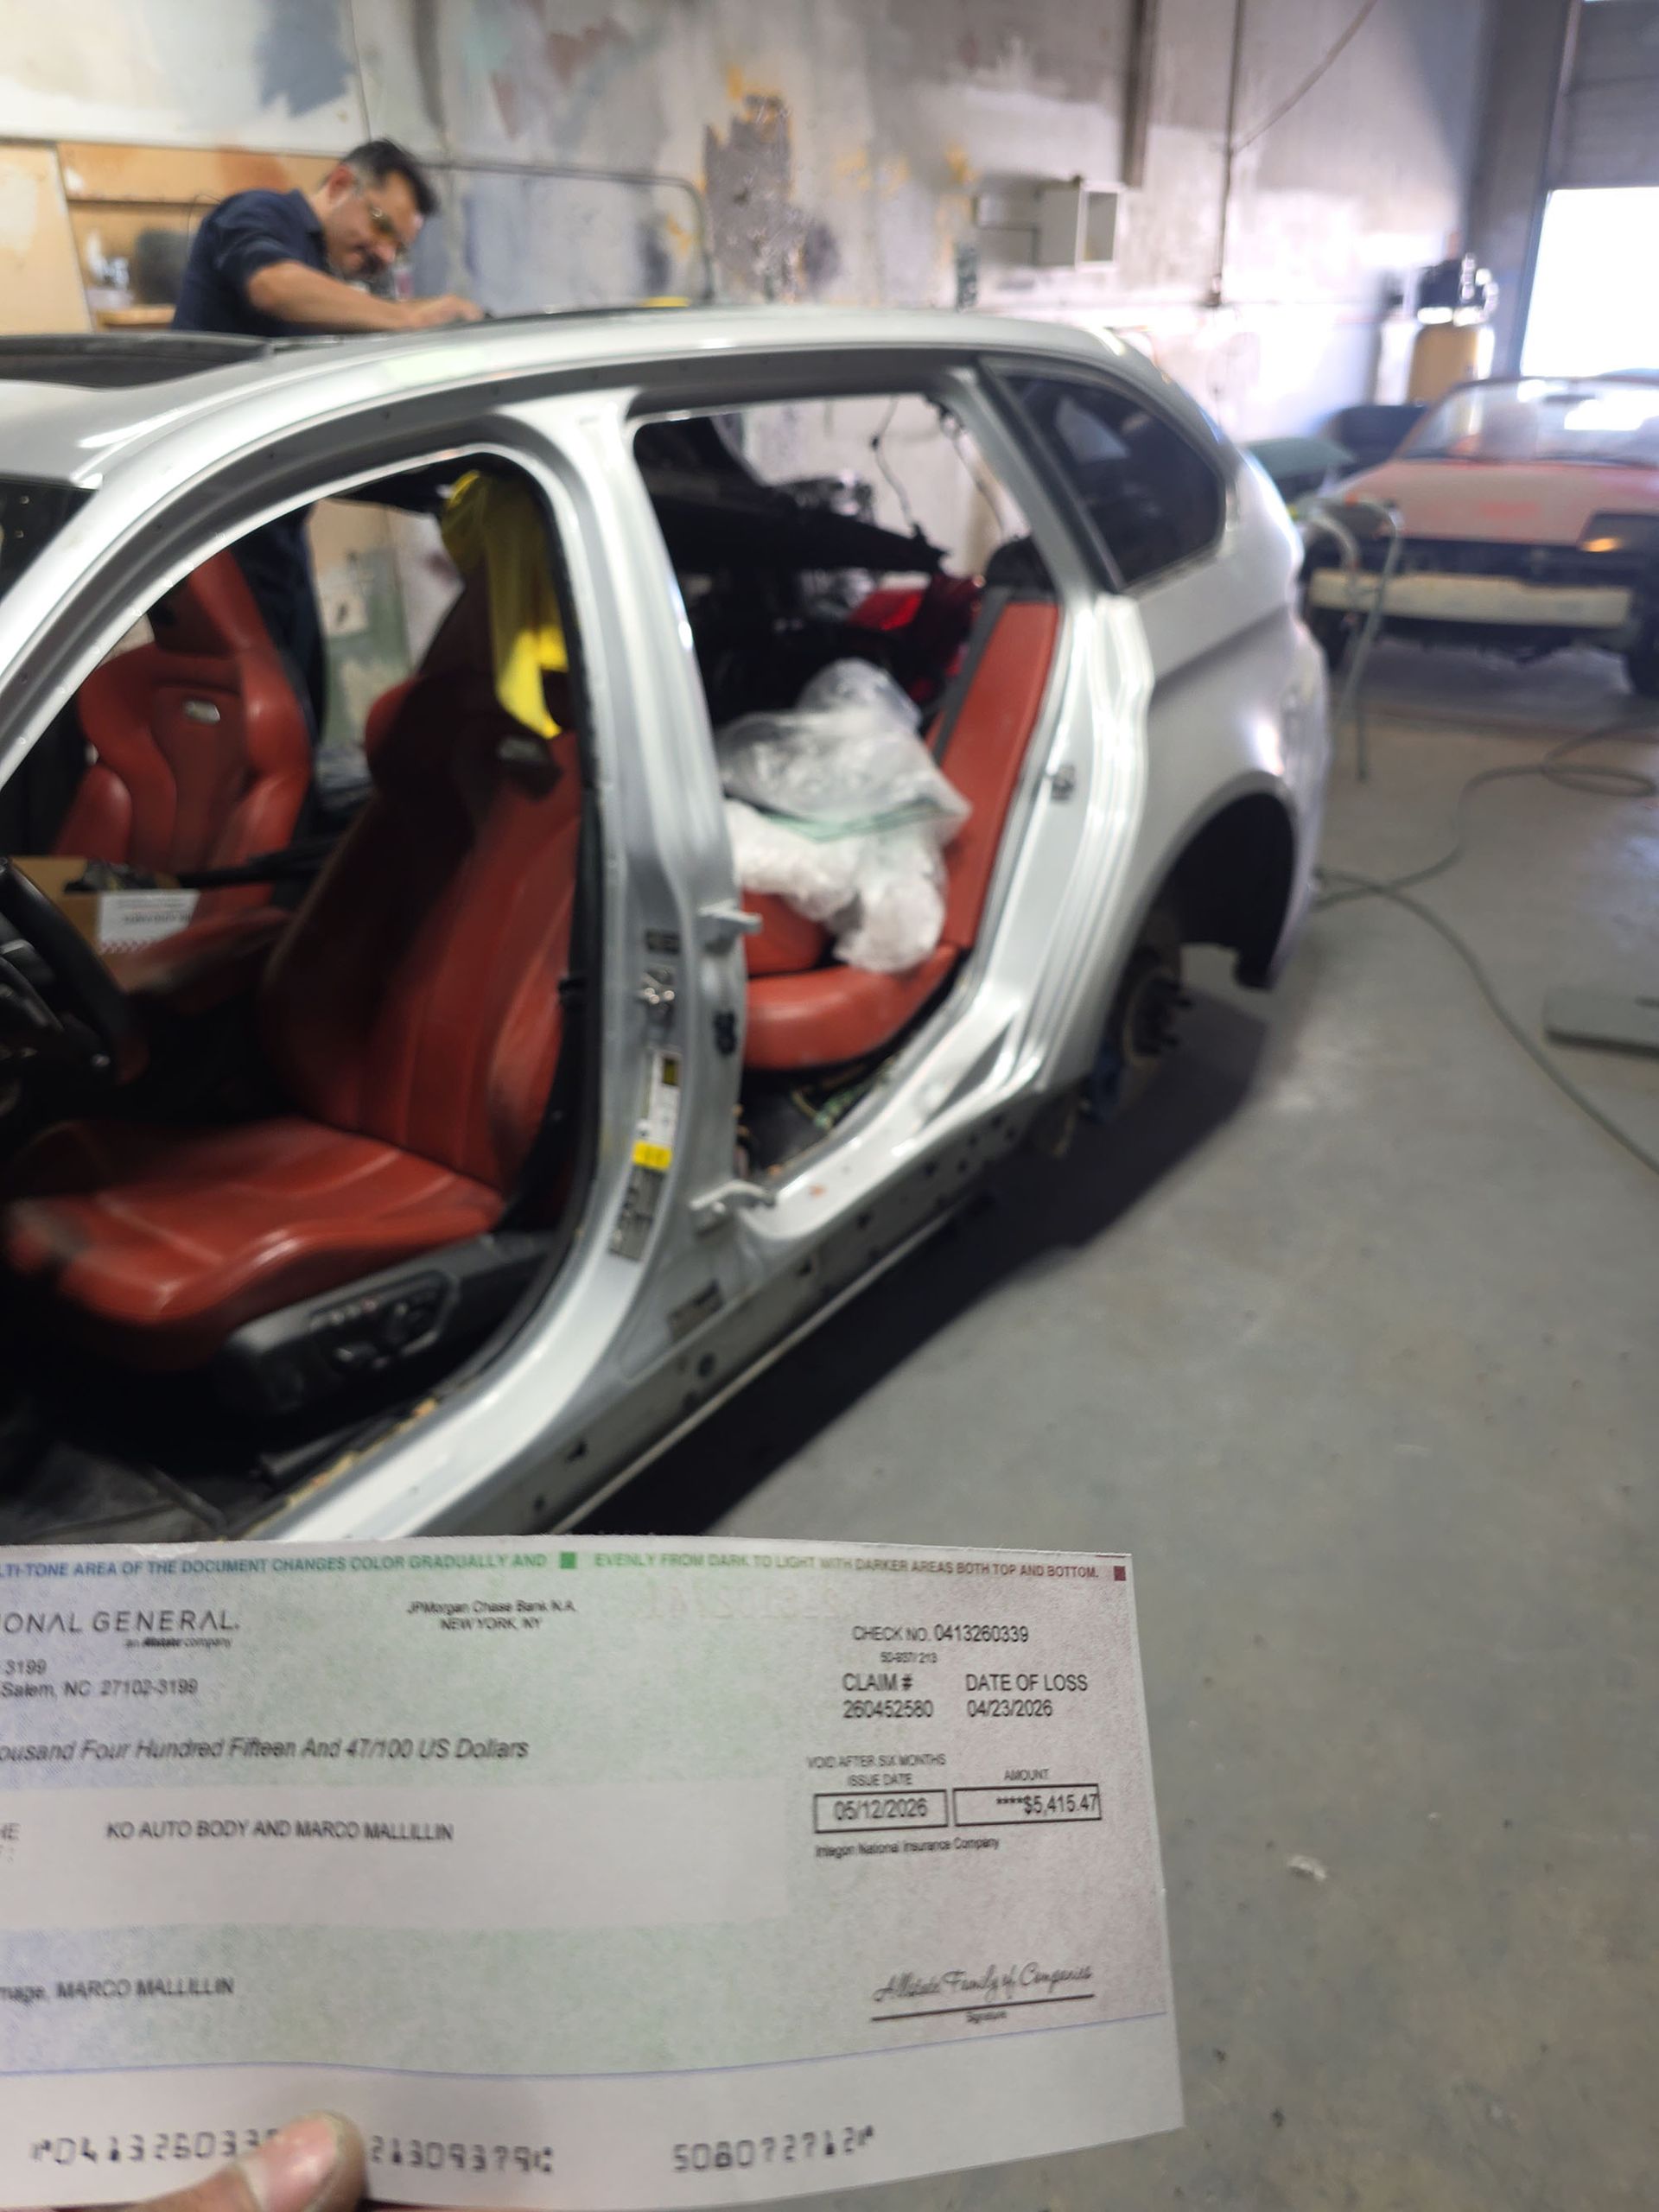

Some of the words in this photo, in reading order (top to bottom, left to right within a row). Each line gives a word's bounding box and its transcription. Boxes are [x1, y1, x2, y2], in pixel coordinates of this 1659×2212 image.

[73, 1561, 118, 1577] AREA
[122, 1560, 143, 1575] OF
[147, 1559, 175, 1574] THE
[181, 1558, 267, 1574] DOCUMENT
[273, 1556, 346, 1572] CHANGES
[351, 1556, 405, 1571] COLOR
[410, 1554, 507, 1569] GRADUALLY
[512, 1554, 548, 1568] AND
[594, 1553, 653, 1567] EVENLY
[660, 1554, 705, 1567] FROM
[709, 1554, 748, 1567] DARK
[753, 1555, 772, 1568] TO
[777, 1555, 816, 1569] LIGHT
[820, 1556, 852, 1570] WITH
[855, 1558, 909, 1573] DARKER
[911, 1560, 954, 1574] AREAS
[956, 1561, 990, 1575] BOTH
[992, 1562, 1016, 1576] TOP
[1020, 1563, 1044, 1578] AND
[1047, 1565, 1099, 1580] BOTTOM.
[407, 1600, 469, 1616] JPMorgan
[474, 1599, 512, 1613] Chase
[517, 1599, 548, 1613] Bank
[0, 1612, 83, 1634] ONAL
[440, 1617, 474, 1630] NEW
[522, 1616, 542, 1630] NY
[852, 1625, 903, 1642] CHECK
[906, 1627, 931, 1643] NO.
[933, 1624, 1028, 1643] 0413260339
[5, 1659, 47, 1676] 3199
[64, 1681, 92, 1697] NC
[100, 1678, 198, 1696] 27102-3199
[842, 1673, 898, 1691] CLAIM
[902, 1673, 913, 1691] #
[965, 1673, 1012, 1692] DATE
[1015, 1673, 1039, 1692] OF
[1043, 1673, 1089, 1692] LOSS
[966, 1699, 1053, 1718] 04/23/2026
[81, 1738, 130, 1759] Four
[136, 1738, 226, 1758] Hundred
[229, 1737, 296, 1758] Fifteen
[302, 1738, 342, 1758] And
[346, 1738, 414, 1758] 47/100
[418, 1738, 450, 1758] US
[454, 1738, 531, 1758] Dollars
[807, 1756, 836, 1768] VOID
[839, 1755, 877, 1768] AFTER
[879, 1755, 897, 1767] SIX
[899, 1753, 946, 1766] MONTHS
[847, 1774, 880, 1787] ISSUE
[882, 1773, 912, 1786] DATE
[1004, 1769, 1049, 1782] AMOUNT
[834, 1798, 928, 1821] 05/12/2026
[107, 1821, 135, 1840] KO
[138, 1820, 192, 1840] AUTO
[196, 1820, 250, 1839] BODY
[252, 1820, 292, 1839] AND
[296, 1820, 359, 1839] MARCO
[364, 1821, 454, 1841] MALLILLIN
[858, 1841, 899, 1855] National
[903, 1840, 950, 1853] Insurance
[954, 1837, 1000, 1853] Company
[56, 1979, 131, 1999] MARCO
[136, 1976, 235, 1997] MALLILLIN
[942, 1964, 999, 2003] Family
[1001, 1964, 1018, 2000] of
[1020, 1961, 1093, 1993] Companies
